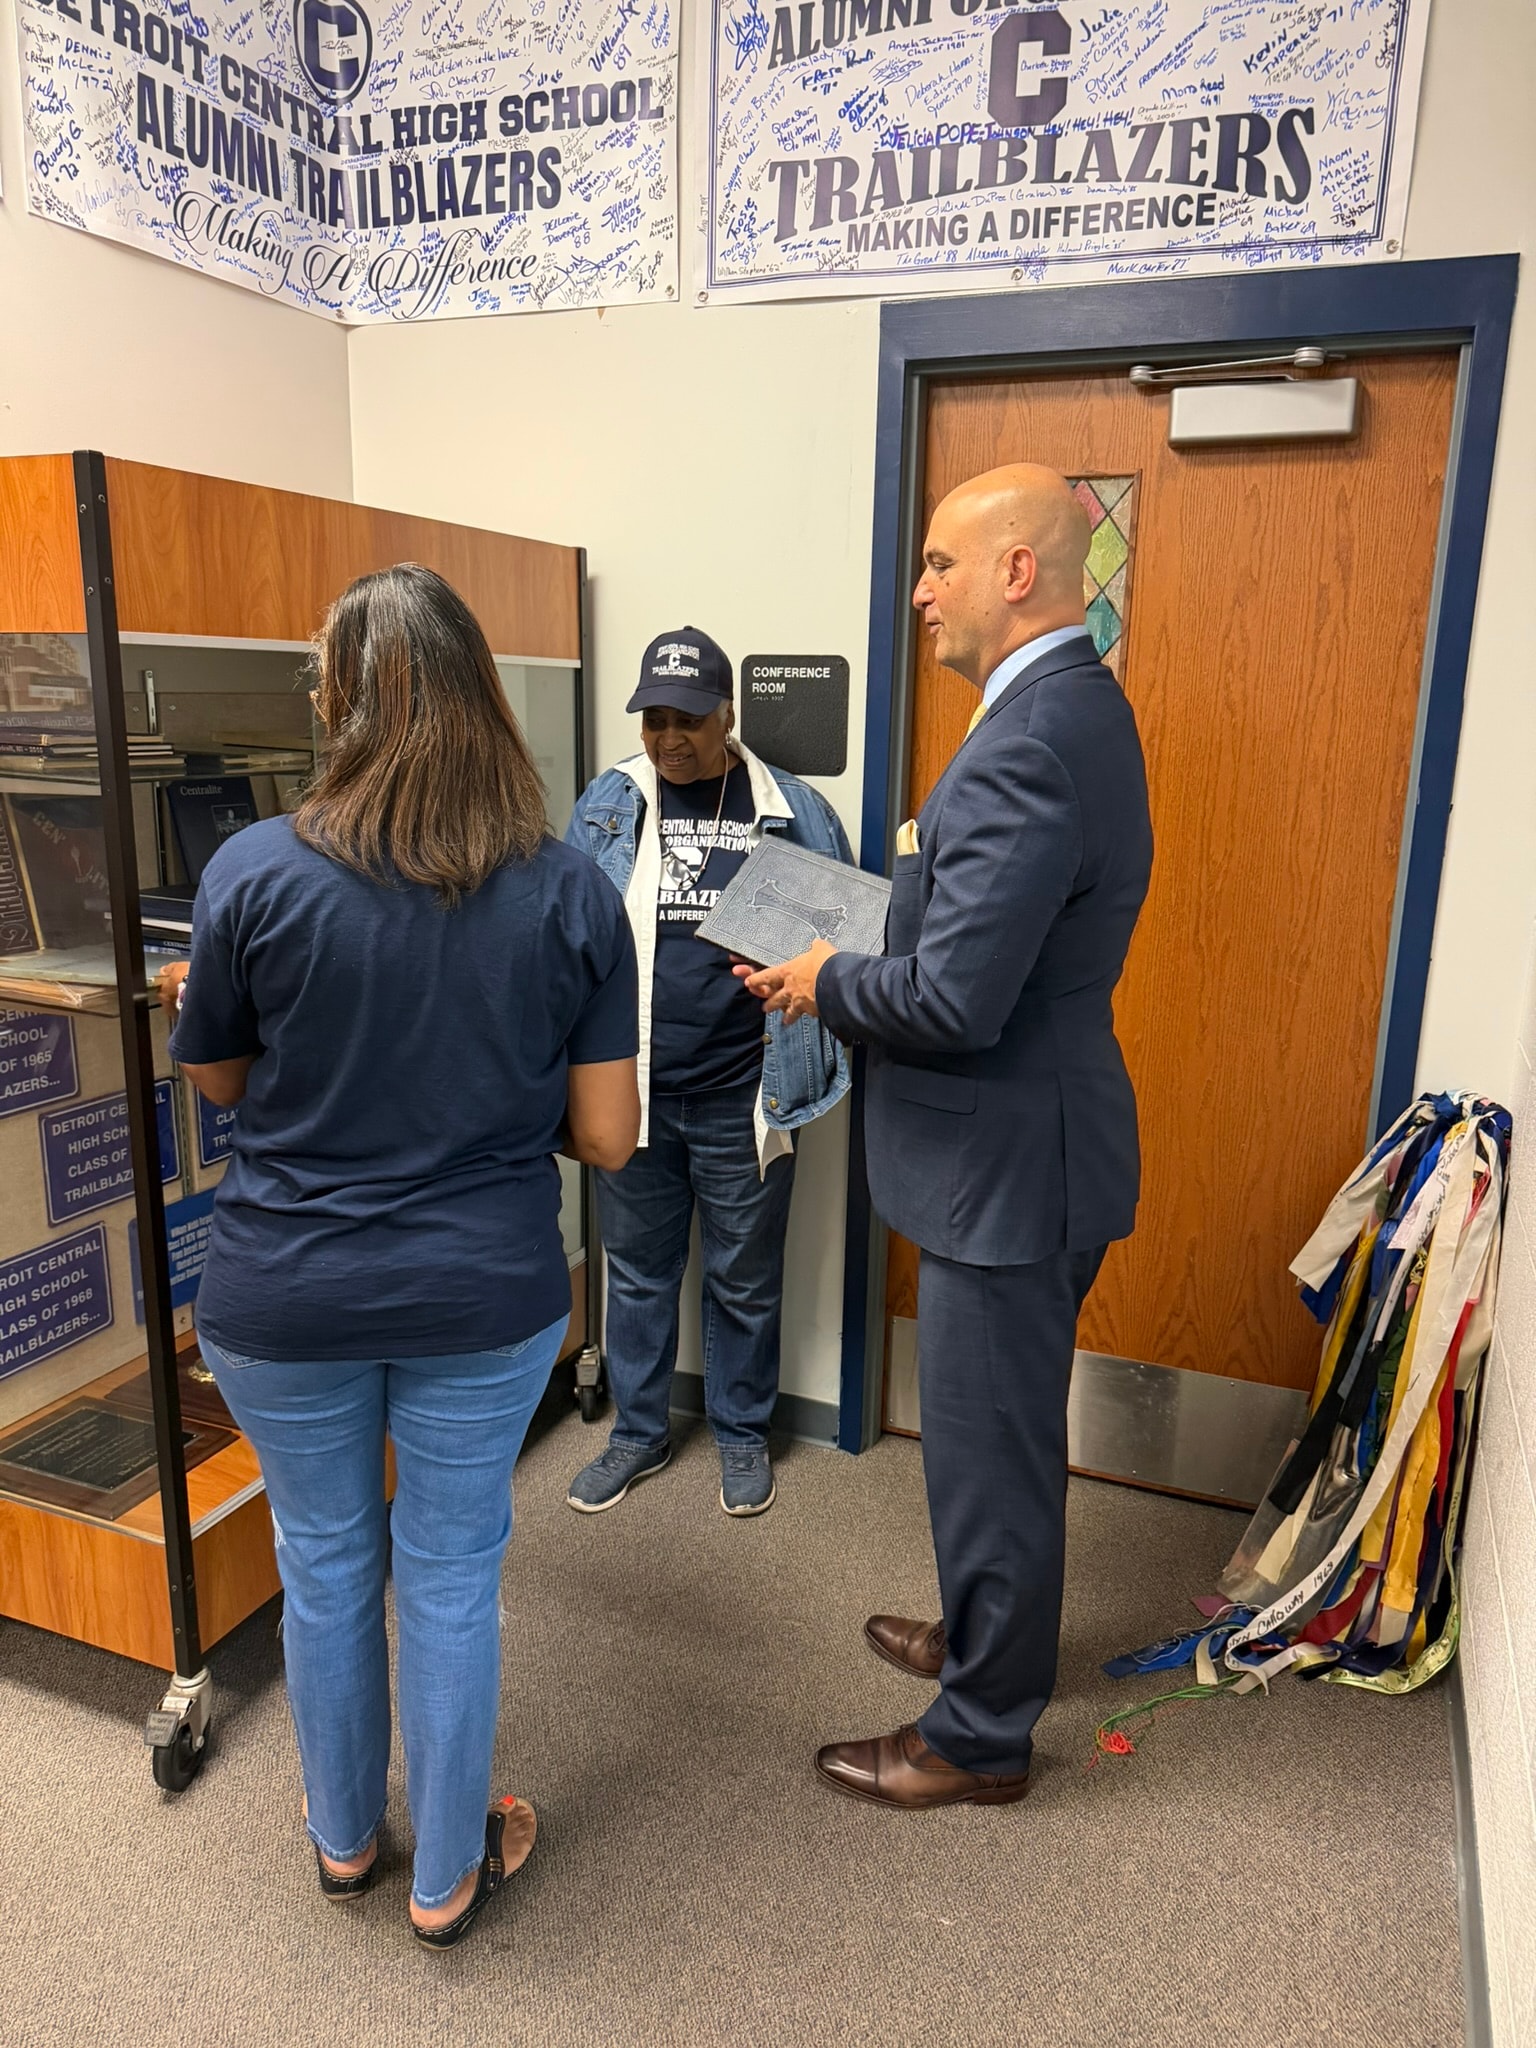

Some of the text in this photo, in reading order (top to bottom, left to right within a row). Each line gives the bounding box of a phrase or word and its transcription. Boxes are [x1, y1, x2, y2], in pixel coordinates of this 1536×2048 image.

[987, 10, 1072, 128] C
[219, 53, 383, 155] CENTRAL
[391, 98, 487, 150] HIGH
[499, 77, 664, 137] SCHOOL
[136, 71, 283, 202] ALUMNI
[290, 146, 562, 230] TRAILBLAZERS
[768, 107, 1315, 244] TRAILBLAZERS
[846, 192, 1217, 253] MAKING A DIFFERENCE
[173, 191, 295, 294] Making
[301, 244, 355, 294] A
[368, 228, 540, 320] Difference
[668, 653, 681, 667] C
[752, 666, 831, 679] CONFERENCE
[751, 682, 786, 693] ROOM
[180, 785, 223, 796] Centralite
[660, 819, 695, 835] ENTRAL
[658, 890, 725, 908] BLAZE
[659, 910, 666, 921] A
[22, 1050, 53, 1068] 1965
[0, 1075, 60, 1098] AZERS...
[52, 1103, 128, 1136] DETROIT CE
[216, 1109, 238, 1126] CLA
[68, 1125, 129, 1155] HIGH SCH
[68, 1148, 128, 1178] CLASS OF
[38, 1240, 100, 1274] CENTRAL
[31, 1268, 88, 1302] SCHOOL
[41, 1303, 60, 1321] OF
